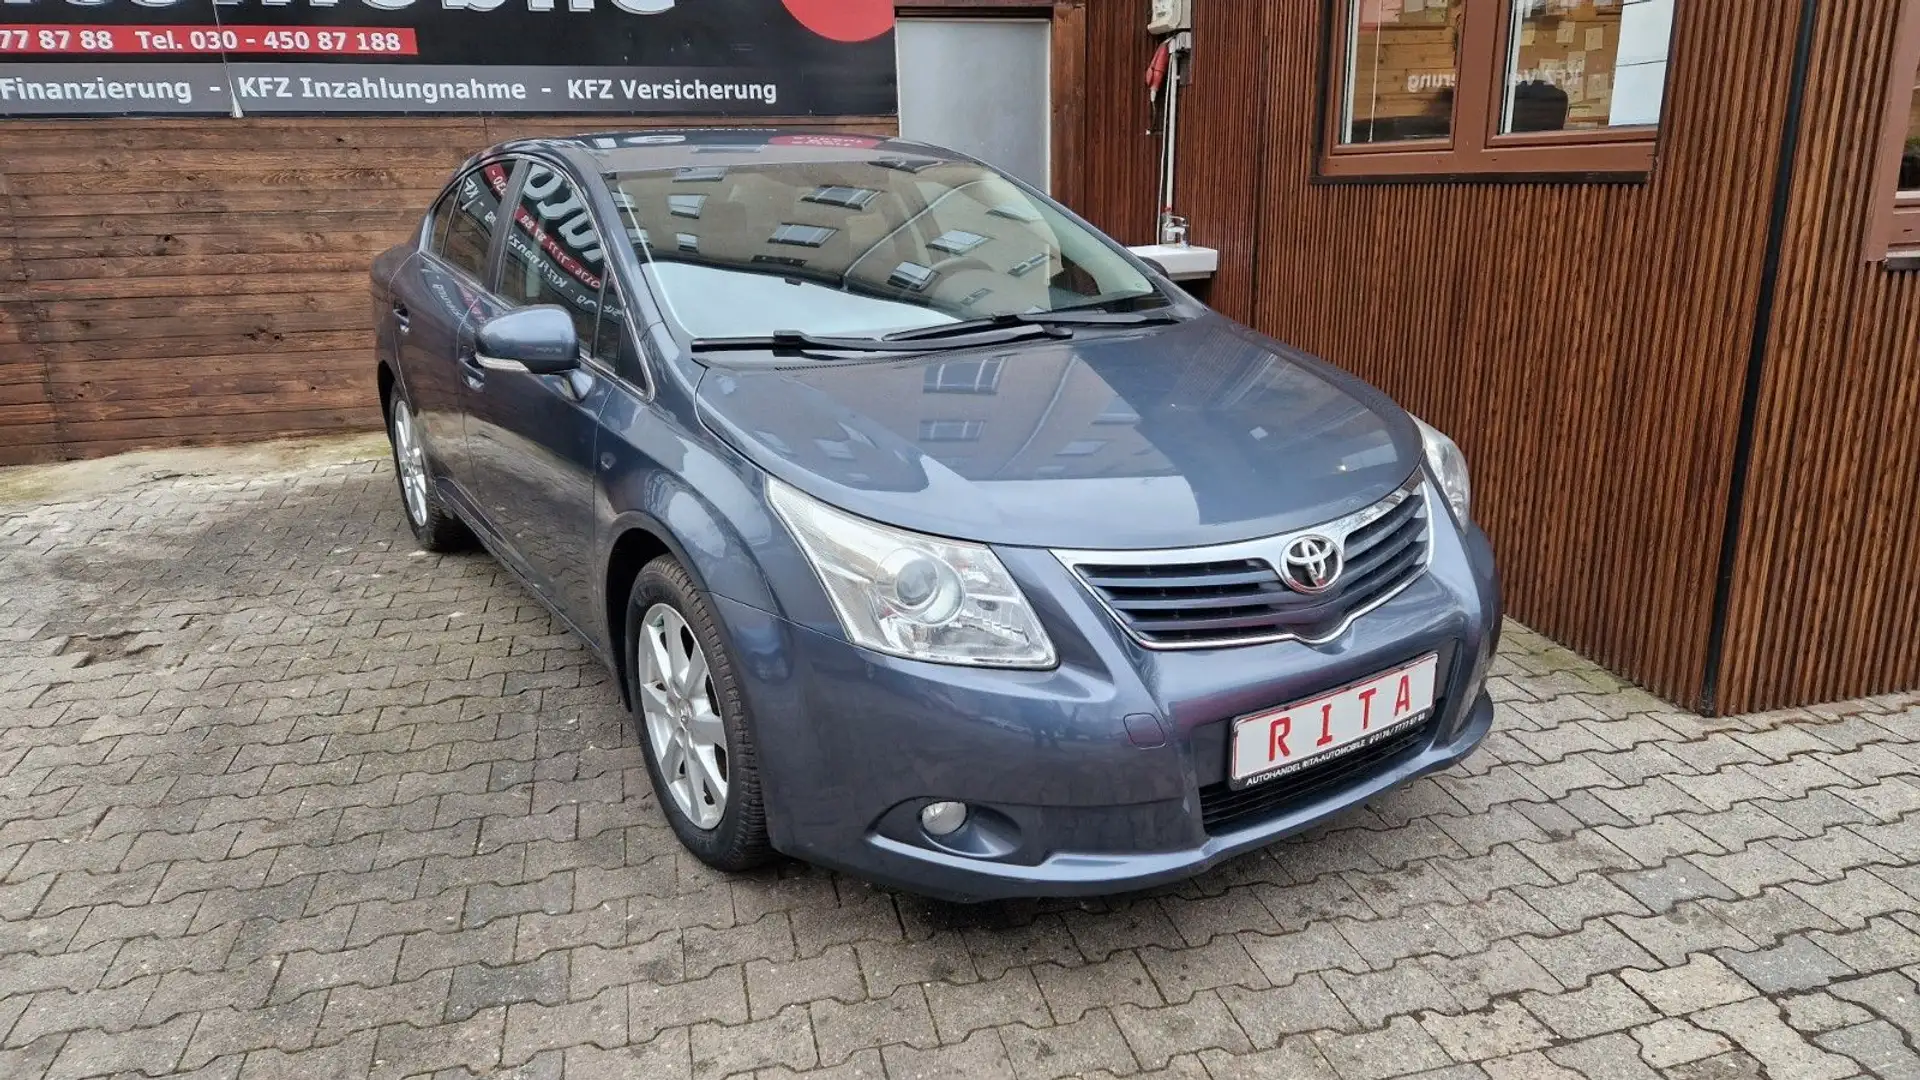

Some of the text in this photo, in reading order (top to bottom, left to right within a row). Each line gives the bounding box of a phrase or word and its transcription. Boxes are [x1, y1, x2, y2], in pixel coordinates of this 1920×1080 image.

[0, 30, 29, 49] 77
[38, 30, 70, 49] 87
[79, 30, 114, 49] 88
[135, 31, 183, 49] Tel.
[190, 31, 238, 49] 030
[264, 31, 310, 50] 450
[317, 32, 346, 51] 87
[357, 33, 400, 51] 188
[0, 77, 192, 104] Finanzierung
[239, 77, 293, 98] KFZ
[300, 77, 526, 103] Inzahlungnahme
[567, 79, 614, 99] KFZ
[620, 79, 777, 103] Versicherung
[1246, 763, 1301, 785] AUTOHANDEL
[1301, 739, 1366, 769] RITA-AUTOMOBILE
